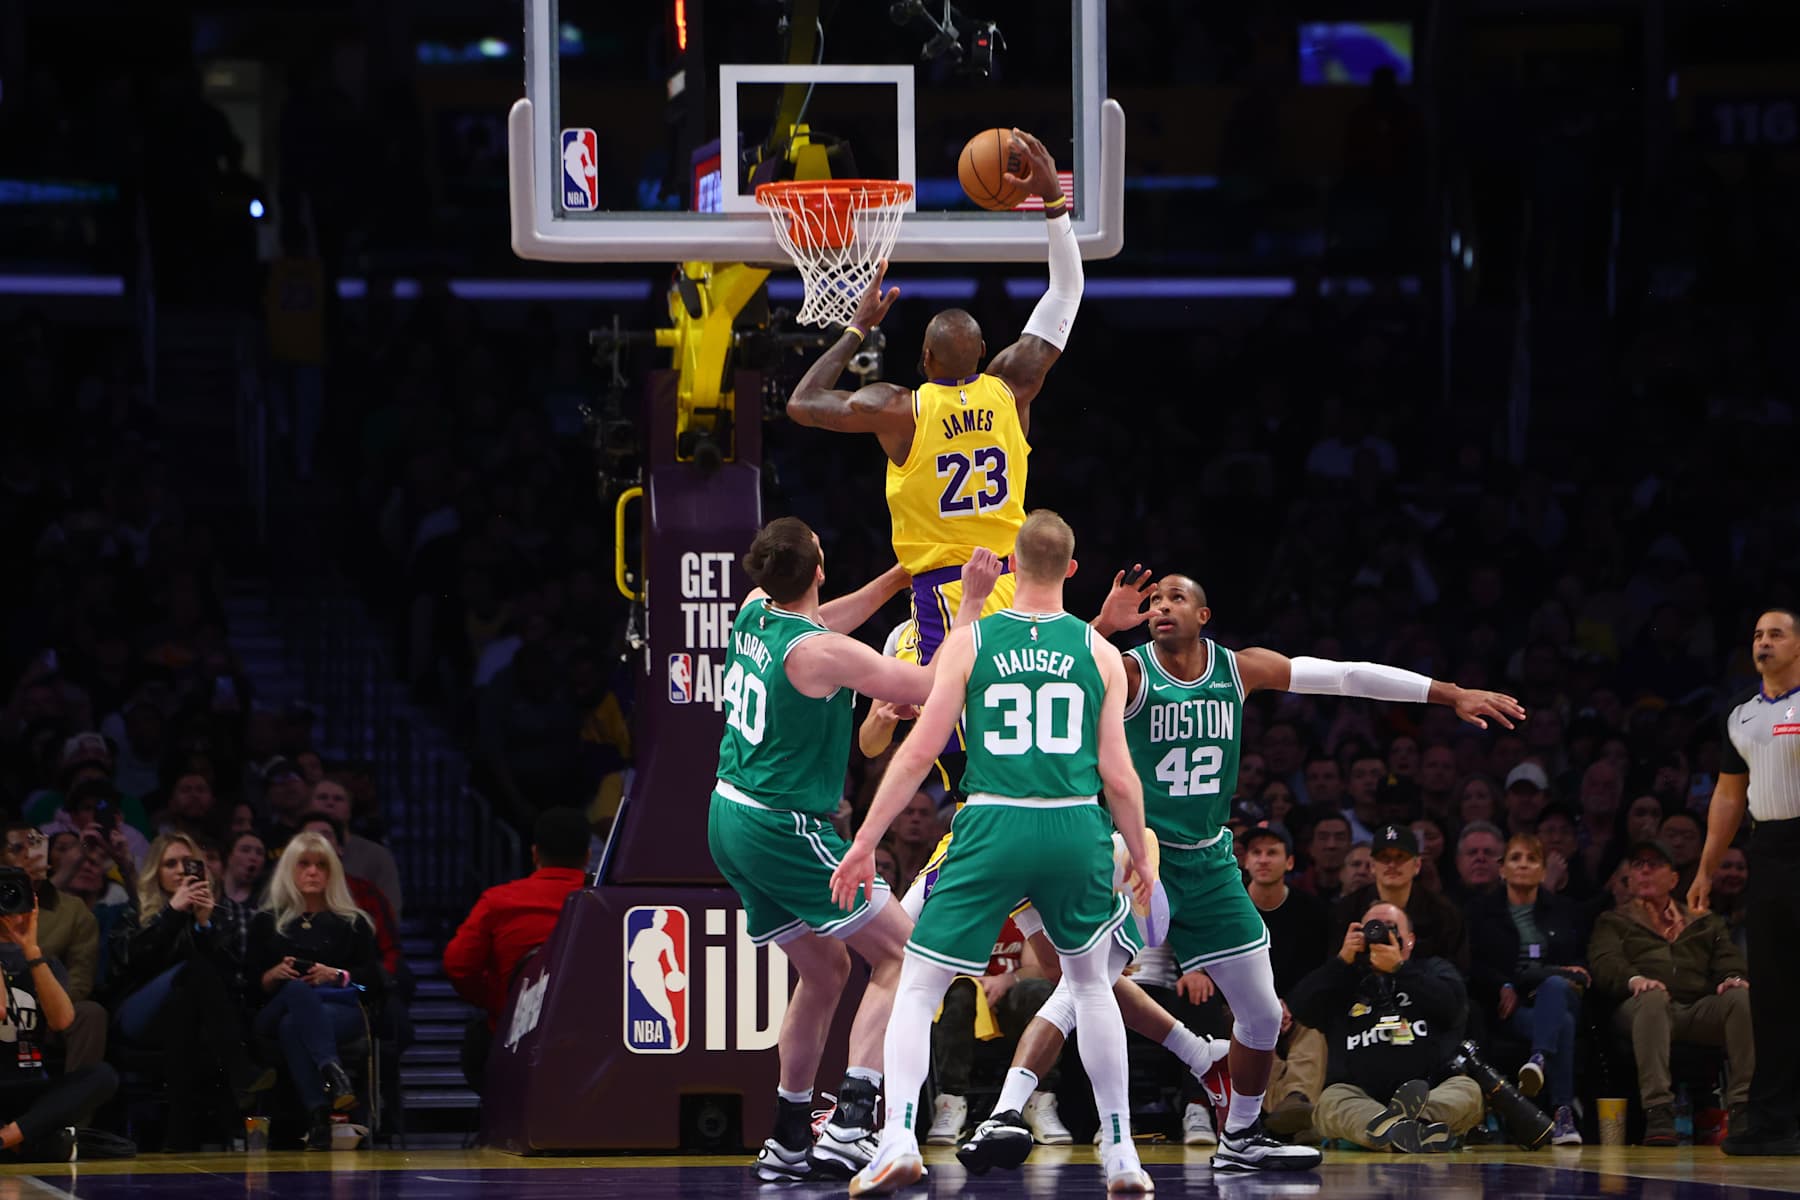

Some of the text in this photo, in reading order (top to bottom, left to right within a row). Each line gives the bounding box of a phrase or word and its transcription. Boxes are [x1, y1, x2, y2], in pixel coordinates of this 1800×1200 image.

[567, 191, 585, 206] NBA
[942, 409, 994, 439] JAMES
[936, 446, 1010, 518] 23
[681, 552, 735, 598] GET
[680, 602, 736, 648] THE
[735, 631, 772, 674] KORNET
[992, 648, 1075, 679] HAUSER
[695, 654, 727, 712] Ap
[724, 660, 767, 746] 40
[983, 682, 1085, 755] 30
[1150, 699, 1234, 742] BOSTON
[1155, 745, 1223, 796] 42
[633, 909, 789, 1050] NBA iD
[1346, 1019, 1428, 1051] PHOO
